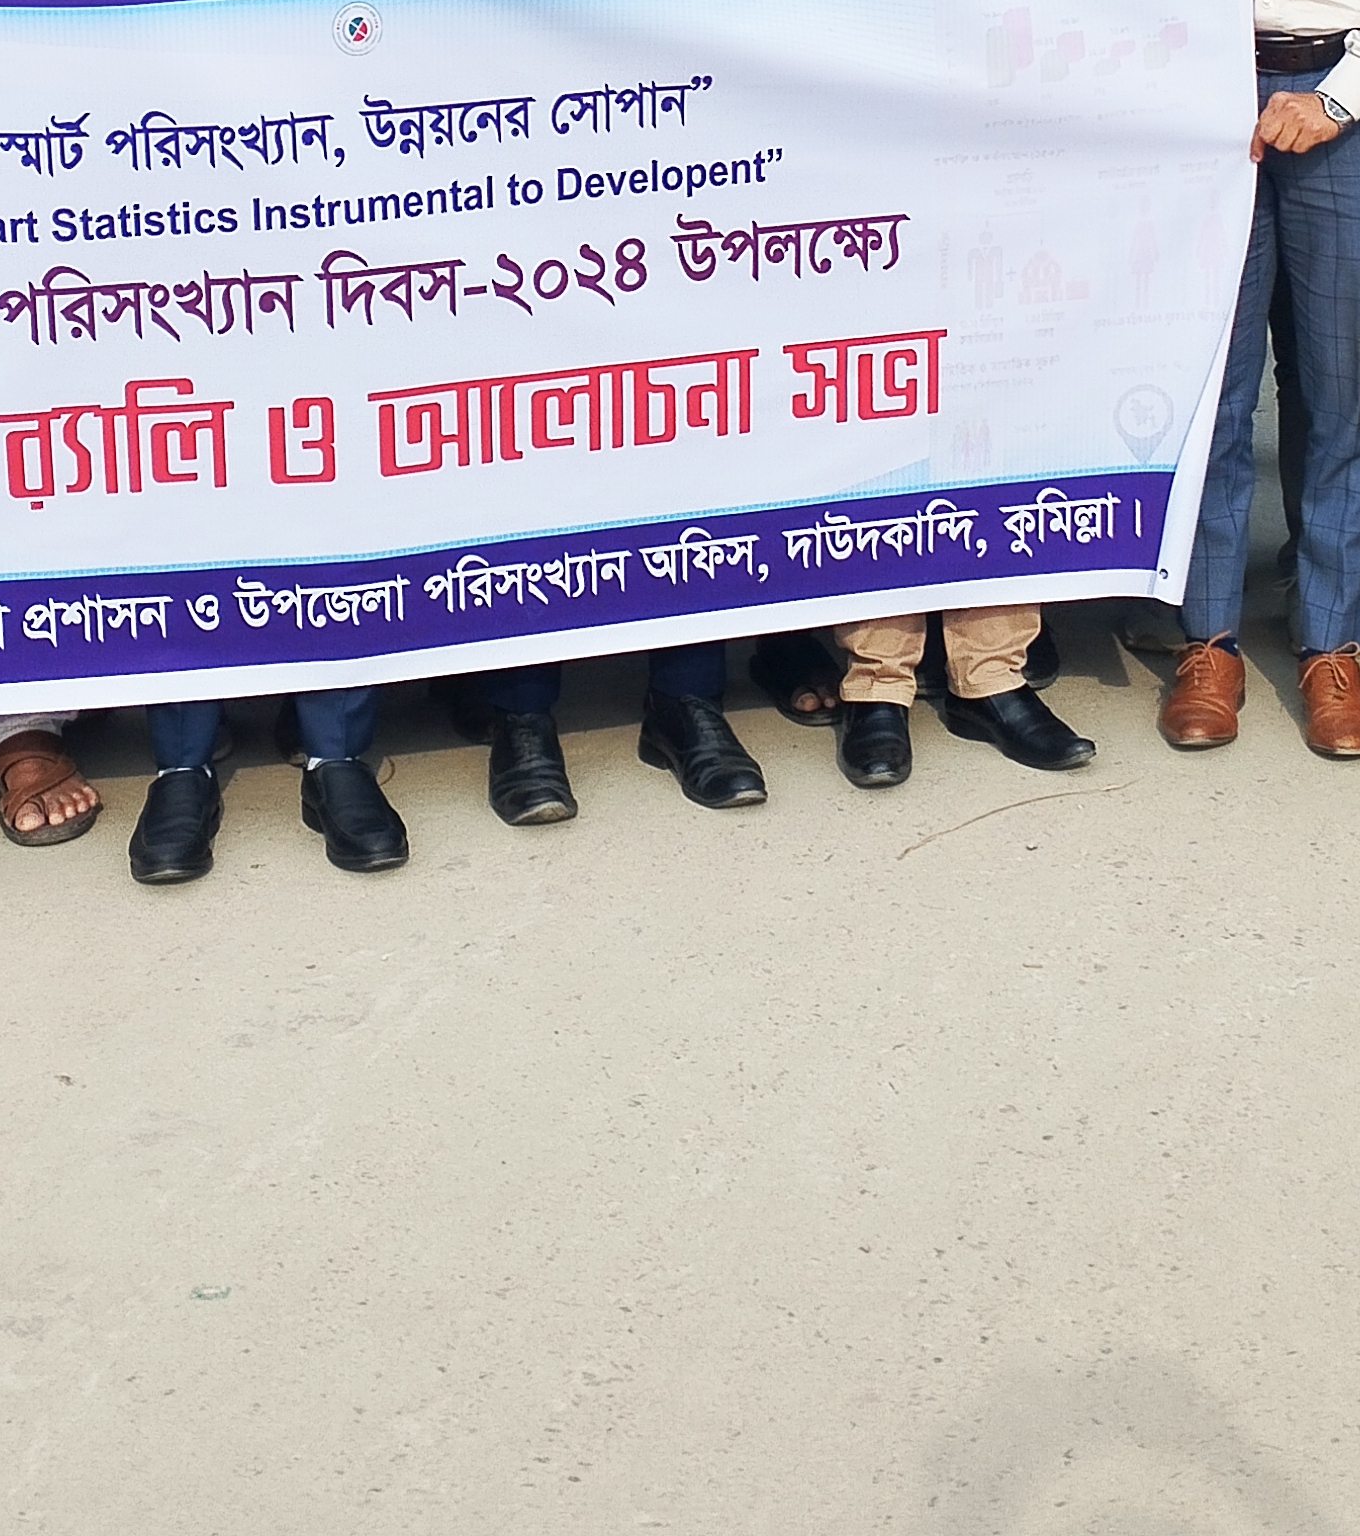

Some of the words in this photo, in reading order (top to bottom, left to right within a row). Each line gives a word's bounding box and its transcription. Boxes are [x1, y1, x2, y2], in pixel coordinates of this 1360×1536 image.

[105, 110, 345, 171] পরিসংখ্যান,
[360, 94, 536, 159] উন্নয়নের
[551, 75, 713, 135] সোপান”
[51, 202, 239, 243] Statistics
[253, 175, 494, 231] Instrumental
[506, 173, 544, 206] to
[556, 148, 784, 202] Developent”
[315, 237, 648, 329] দিবস-২০২৪
[671, 213, 911, 283] উপলক্ষ্যে
[267, 396, 336, 484] ও
[367, 347, 760, 478] আলোচনা
[783, 328, 948, 424] সভা
[21, 593, 174, 646] প্রশাসন
[186, 590, 220, 631] ও
[232, 573, 410, 631] উপজেলা
[423, 548, 632, 613] পরিসংখ্যান
[640, 527, 770, 586] অফিস,
[783, 498, 987, 569] দাউদকান্দি,
